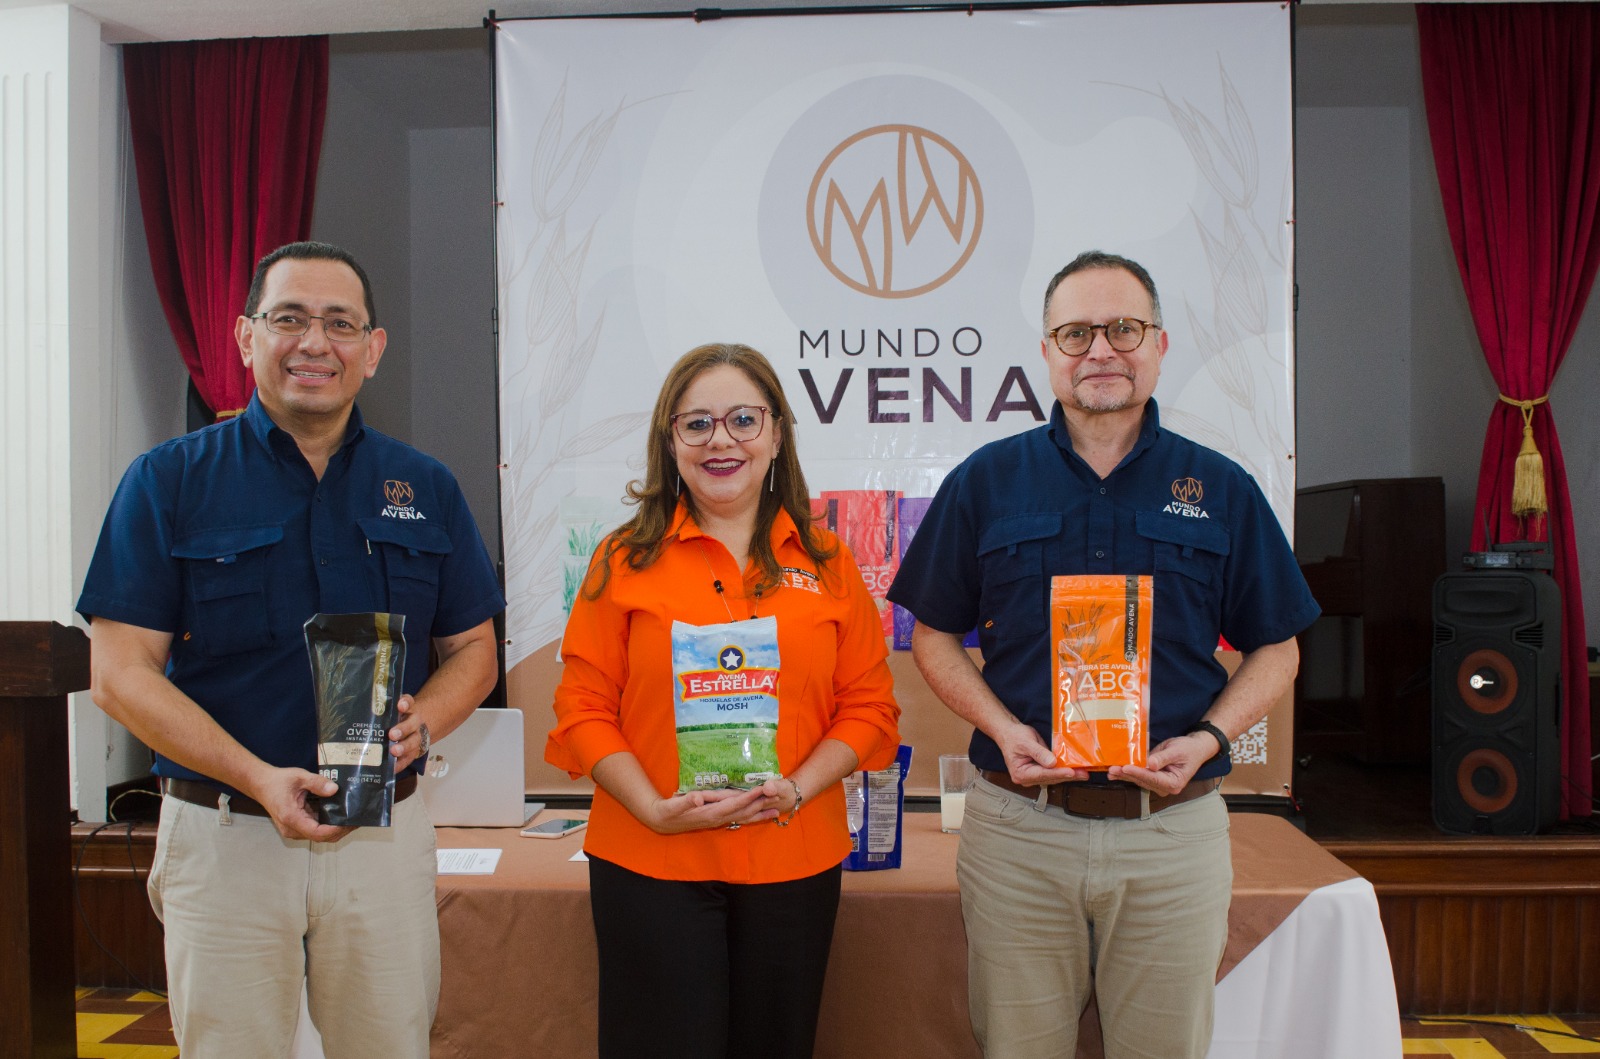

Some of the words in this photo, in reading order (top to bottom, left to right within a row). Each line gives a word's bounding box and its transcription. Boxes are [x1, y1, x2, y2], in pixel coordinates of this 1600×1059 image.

[799, 326, 983, 359] MUNDO
[794, 365, 1047, 424] VENA
[381, 508, 427, 520] AVENA
[1162, 504, 1210, 519] AVENA
[1171, 501, 1201, 512] MUNDO
[862, 571, 891, 591] BG
[1127, 627, 1135, 651] MUNDO
[378, 646, 387, 673] AVENA
[690, 675, 774, 694] ESTRELLA
[717, 672, 747, 681] AVENA
[1078, 671, 1137, 692] ABG
[717, 702, 748, 711] MOSH
[347, 728, 385, 737] avena
